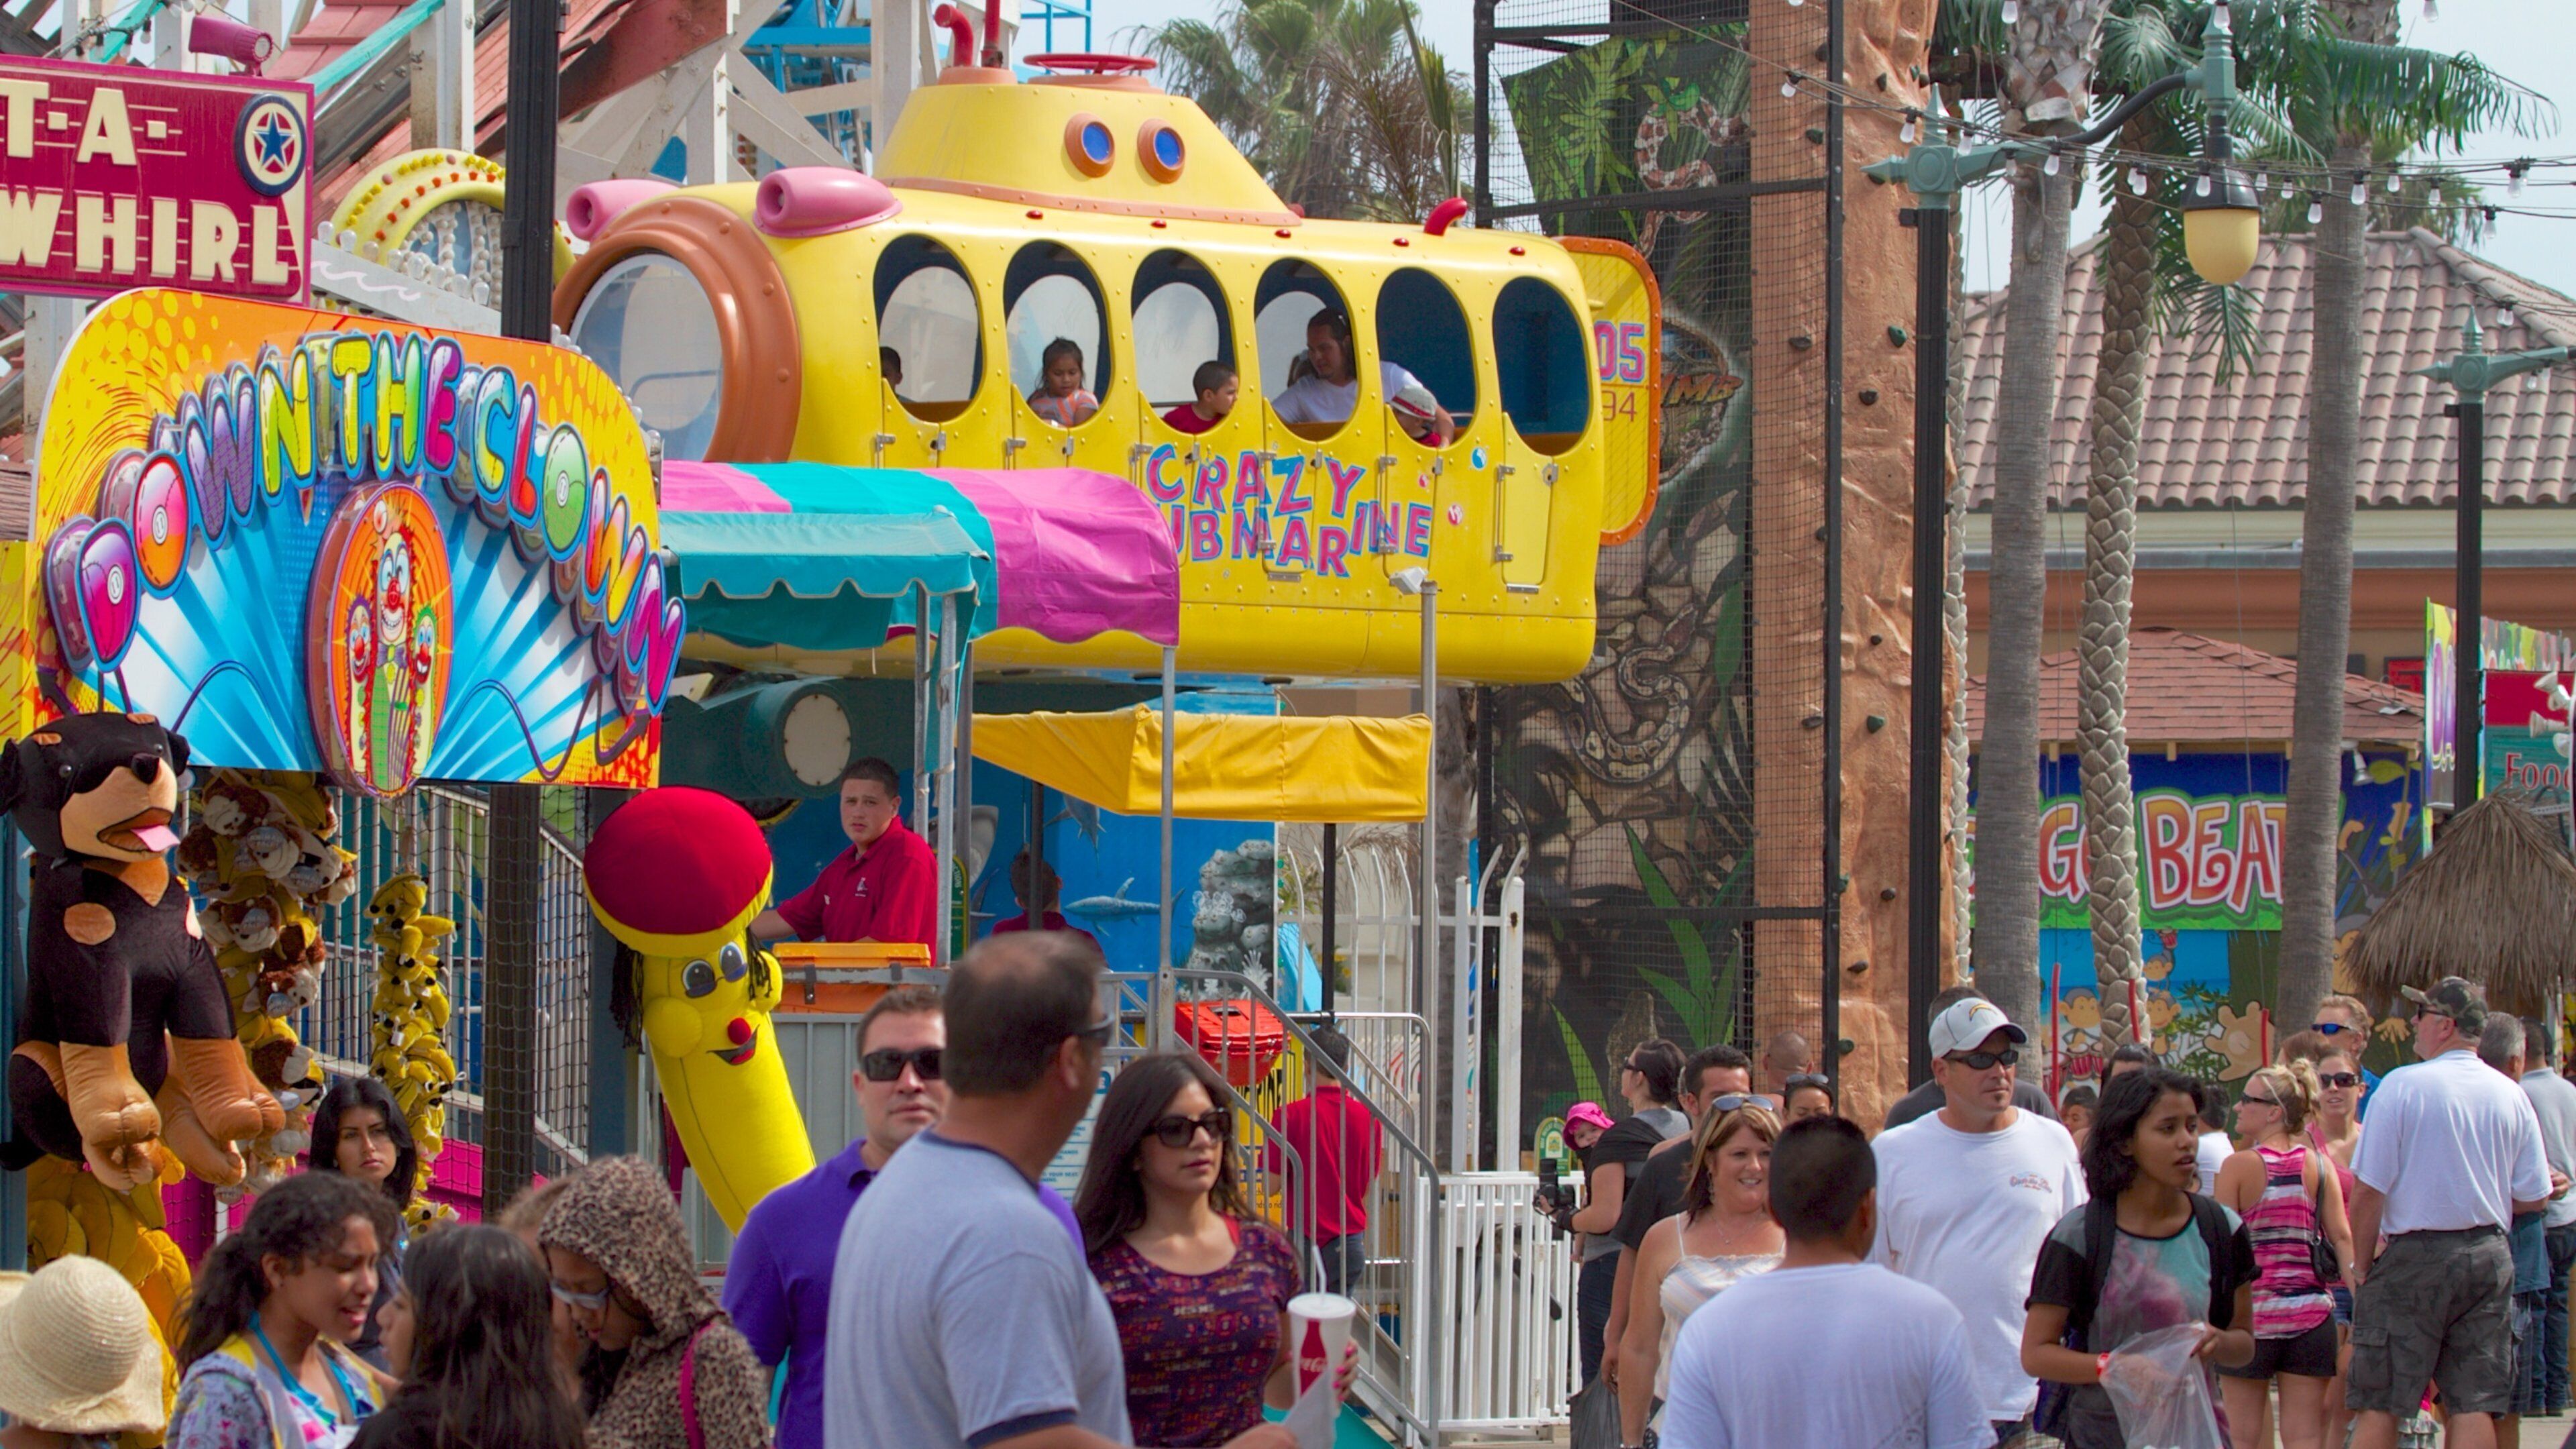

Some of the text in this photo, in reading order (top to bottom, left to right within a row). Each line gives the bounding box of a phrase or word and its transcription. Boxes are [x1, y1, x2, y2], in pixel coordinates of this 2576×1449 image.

[0, 184, 289, 284] WHIRL
[75, 330, 686, 716] DOWN THE CLOWN
[1146, 443, 1366, 519] CRAZY
[1157, 500, 1433, 578] UBMARINE
